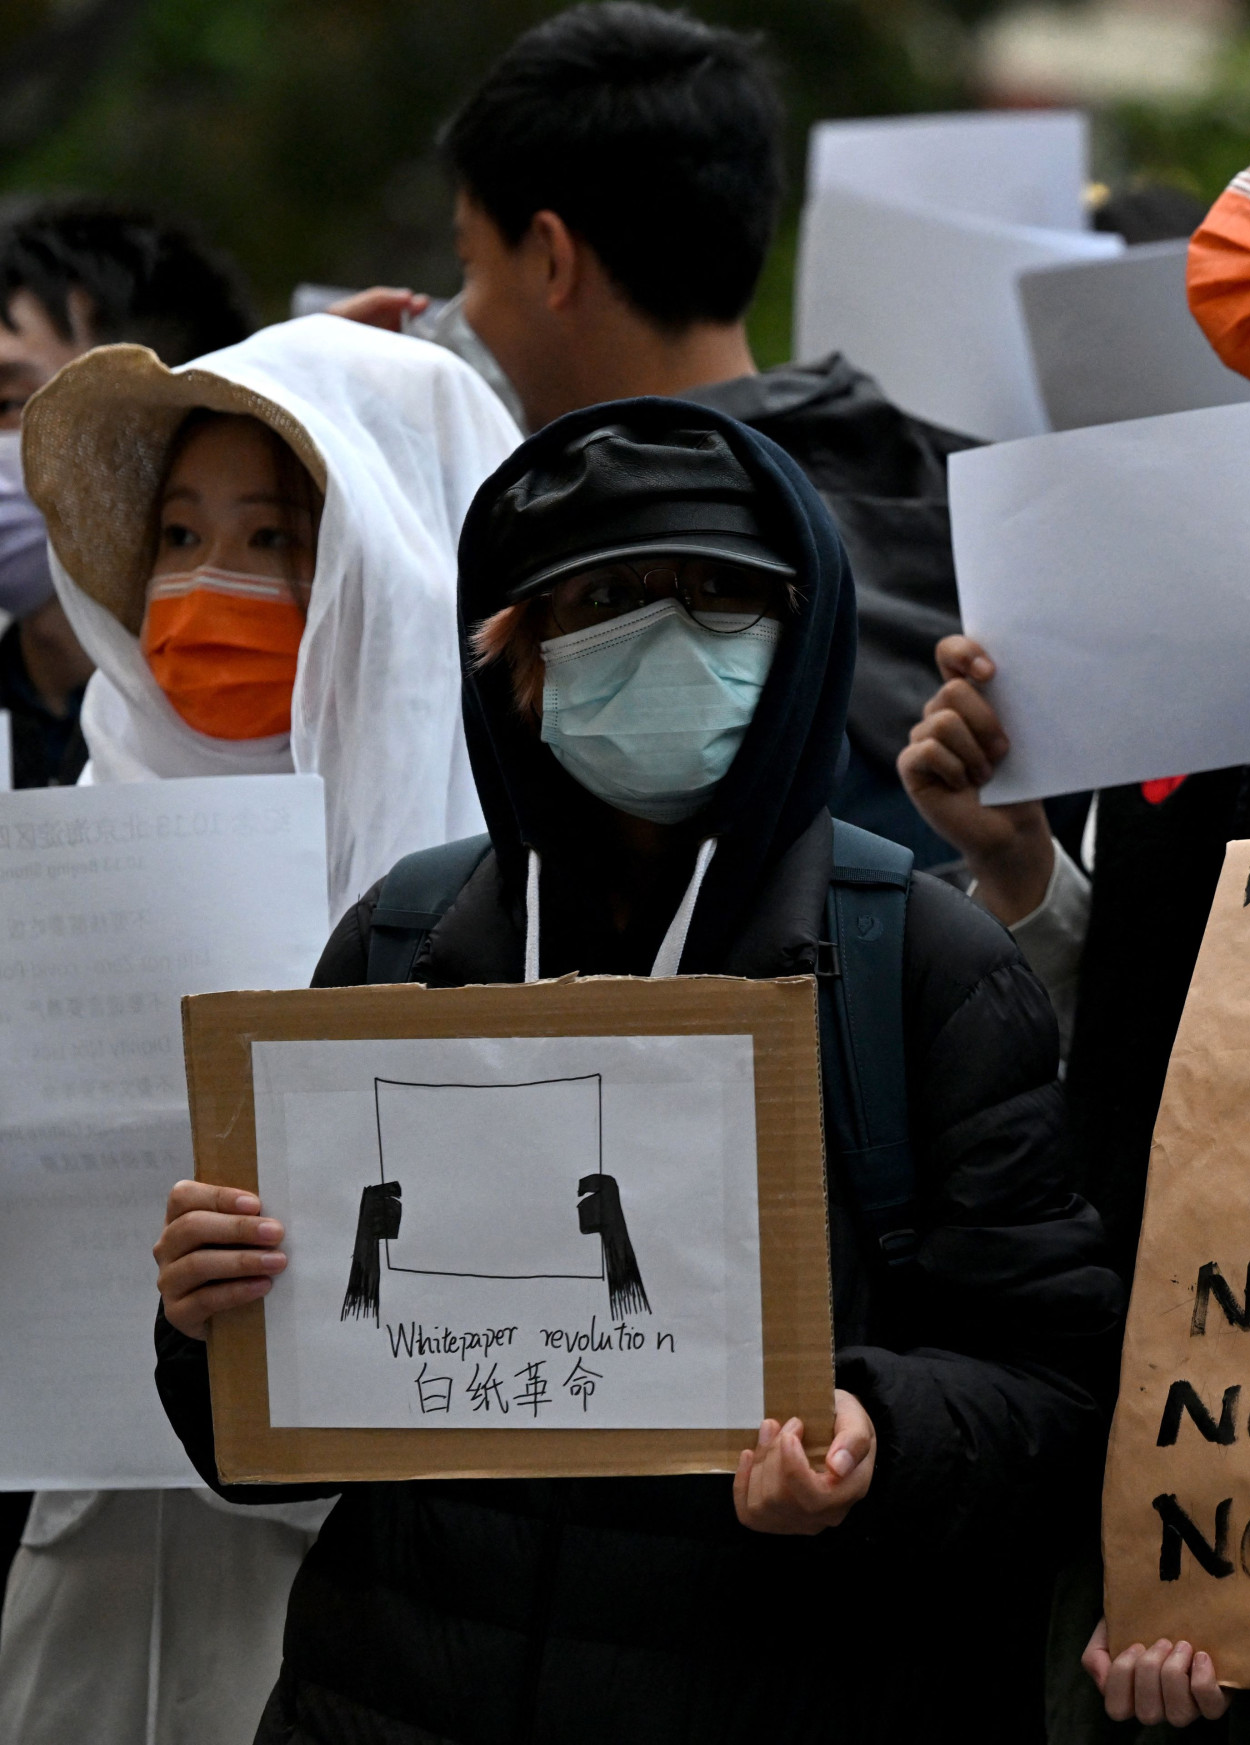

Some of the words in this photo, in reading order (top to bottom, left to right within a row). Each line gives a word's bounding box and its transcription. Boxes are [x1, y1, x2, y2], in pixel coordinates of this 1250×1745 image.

[386, 1321, 518, 1361] Whitepaper
[414, 1356, 603, 1418] 白纸革命
